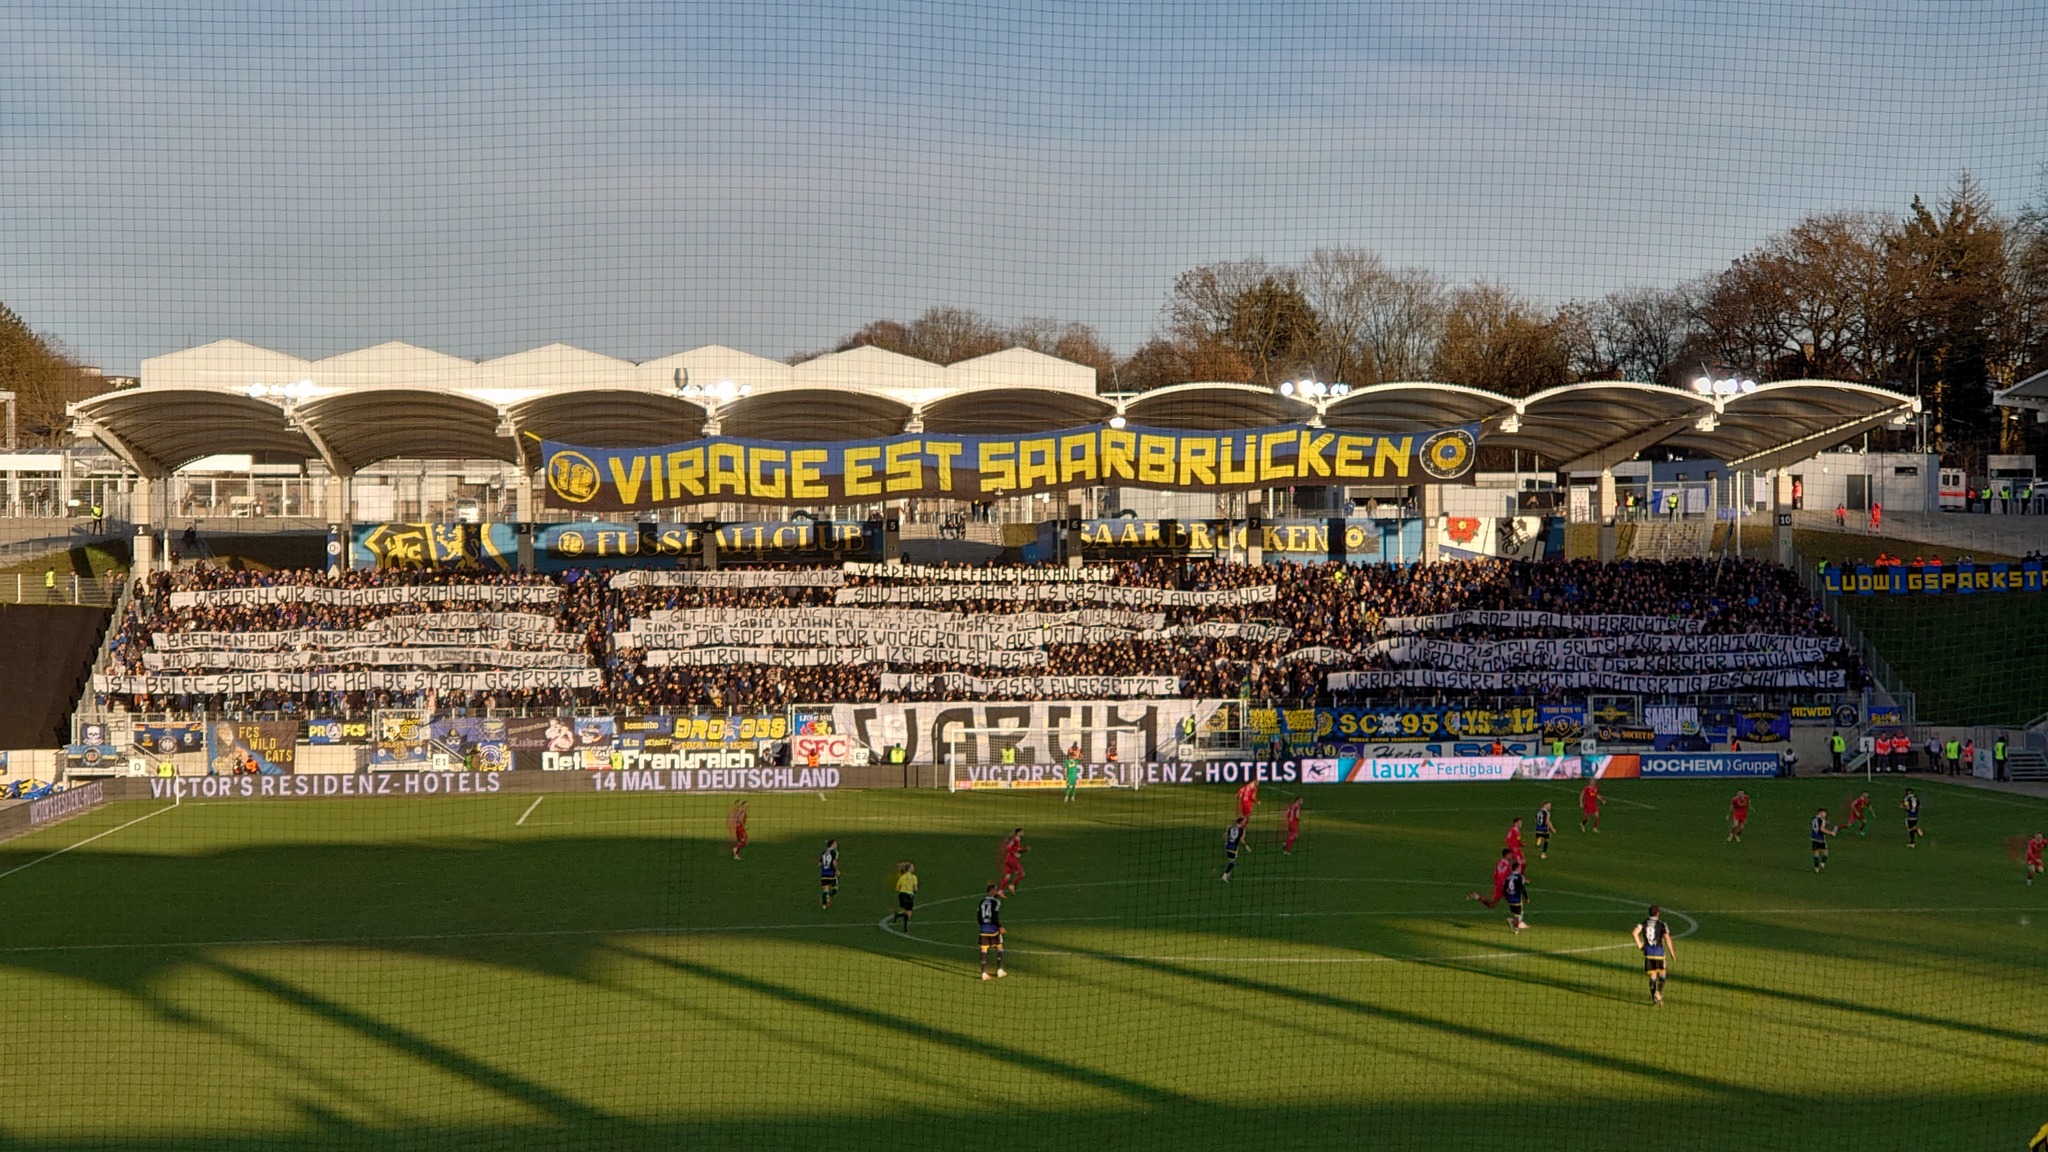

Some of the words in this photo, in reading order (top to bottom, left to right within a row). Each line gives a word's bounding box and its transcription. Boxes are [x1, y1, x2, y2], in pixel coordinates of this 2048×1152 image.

[609, 442, 829, 504] VIRAGE
[844, 440, 962, 497] EST
[979, 430, 1414, 493] SAARBRÜCKEN
[1779, 515, 1791, 524] 10
[629, 572, 660, 586] SIND
[667, 571, 746, 587] POLIZISTEN
[753, 572, 768, 585] IM
[773, 571, 840, 586] STADION?
[194, 588, 269, 607] WERDEN
[276, 586, 305, 603] WIR
[312, 587, 333, 602] SO
[408, 585, 559, 602] KRIMINALISIERT?
[900, 586, 944, 601] MEHR
[950, 585, 1019, 601] BEAMTE
[1026, 585, 1059, 600] ALS
[1171, 586, 1273, 606] ANWESEND?
[1453, 612, 1473, 627] DIE
[1479, 612, 1510, 626] GDP
[1516, 612, 1532, 627] IN
[1538, 612, 1592, 629] ALLEN
[1600, 615, 1700, 631] BERICHTEN?
[632, 632, 689, 648] MACHT
[696, 627, 724, 644] DIE
[730, 629, 764, 645] GDP
[771, 629, 831, 645] WOCHE
[874, 629, 930, 646] WOCHE
[936, 630, 1000, 650] POLITIK
[1006, 630, 1037, 648] AUF
[1043, 627, 1076, 645] DEM
[1562, 637, 1627, 656] SELTEN
[1631, 635, 1663, 651] ZUR
[1667, 634, 1840, 652] VERANTWORTUNG?
[199, 652, 219, 666] DIE
[273, 652, 300, 668] DES
[308, 650, 380, 668] MENSCHEN
[388, 650, 414, 664] VON
[421, 649, 492, 665] POLIZISTEN
[817, 649, 843, 664] DIE
[851, 648, 916, 664] POLIZEI
[923, 650, 960, 663] SICH
[967, 650, 1046, 668] SELBST?
[1409, 649, 1477, 672] WERDEN
[1481, 651, 1559, 673] MENSCHEN
[1565, 653, 1597, 672] AUF
[1602, 656, 1640, 673] DER
[105, 675, 136, 694] IST
[146, 674, 176, 694] BEI
[308, 673, 337, 692] DIE
[344, 672, 408, 691] HALBE
[414, 672, 478, 690] STADT
[485, 670, 600, 690] GESPERRT?
[981, 676, 1045, 694] TASER
[1050, 676, 1175, 695] EINGESETZT?
[1345, 672, 1416, 688] WERDEN
[1422, 670, 1495, 689] UNSERE
[1501, 671, 1571, 689] RECHTE
[1576, 673, 1701, 694] LEICHTFERTIG
[1708, 671, 1840, 691] BESCHNITTEN?
[1338, 714, 1379, 734] SC
[1401, 713, 1439, 733] 95
[1511, 708, 1538, 735] 17
[1644, 707, 1699, 727] SAARLAND
[238, 726, 260, 739] FCS
[343, 724, 367, 737] FCS
[249, 738, 277, 751] WILD
[798, 739, 846, 758] SFC
[1180, 748, 1192, 757] E3
[1583, 742, 1594, 750] E4
[265, 749, 293, 763] CATS
[435, 758, 447, 767] E1
[623, 748, 755, 770] Frankreich
[855, 752, 868, 760] E2
[134, 763, 141, 771] D
[967, 764, 1065, 782] VICTOR'S
[1076, 761, 1297, 783] RESIDENZ-HOTELS
[1373, 759, 1421, 779] laux
[1437, 763, 1503, 778] Fertigbau
[1641, 759, 1724, 772] JOCHEM
[1732, 758, 1777, 774] Gruppe
[151, 776, 253, 798] VICTOR'S
[261, 772, 500, 796] RESIDENZ-HOTELS
[592, 772, 617, 791] 14
[622, 771, 665, 791] MAL
[671, 770, 692, 790] IN
[698, 768, 841, 789] DEUTSCHLAND
[1509, 878, 1516, 891] 6
[981, 903, 992, 918] 14
